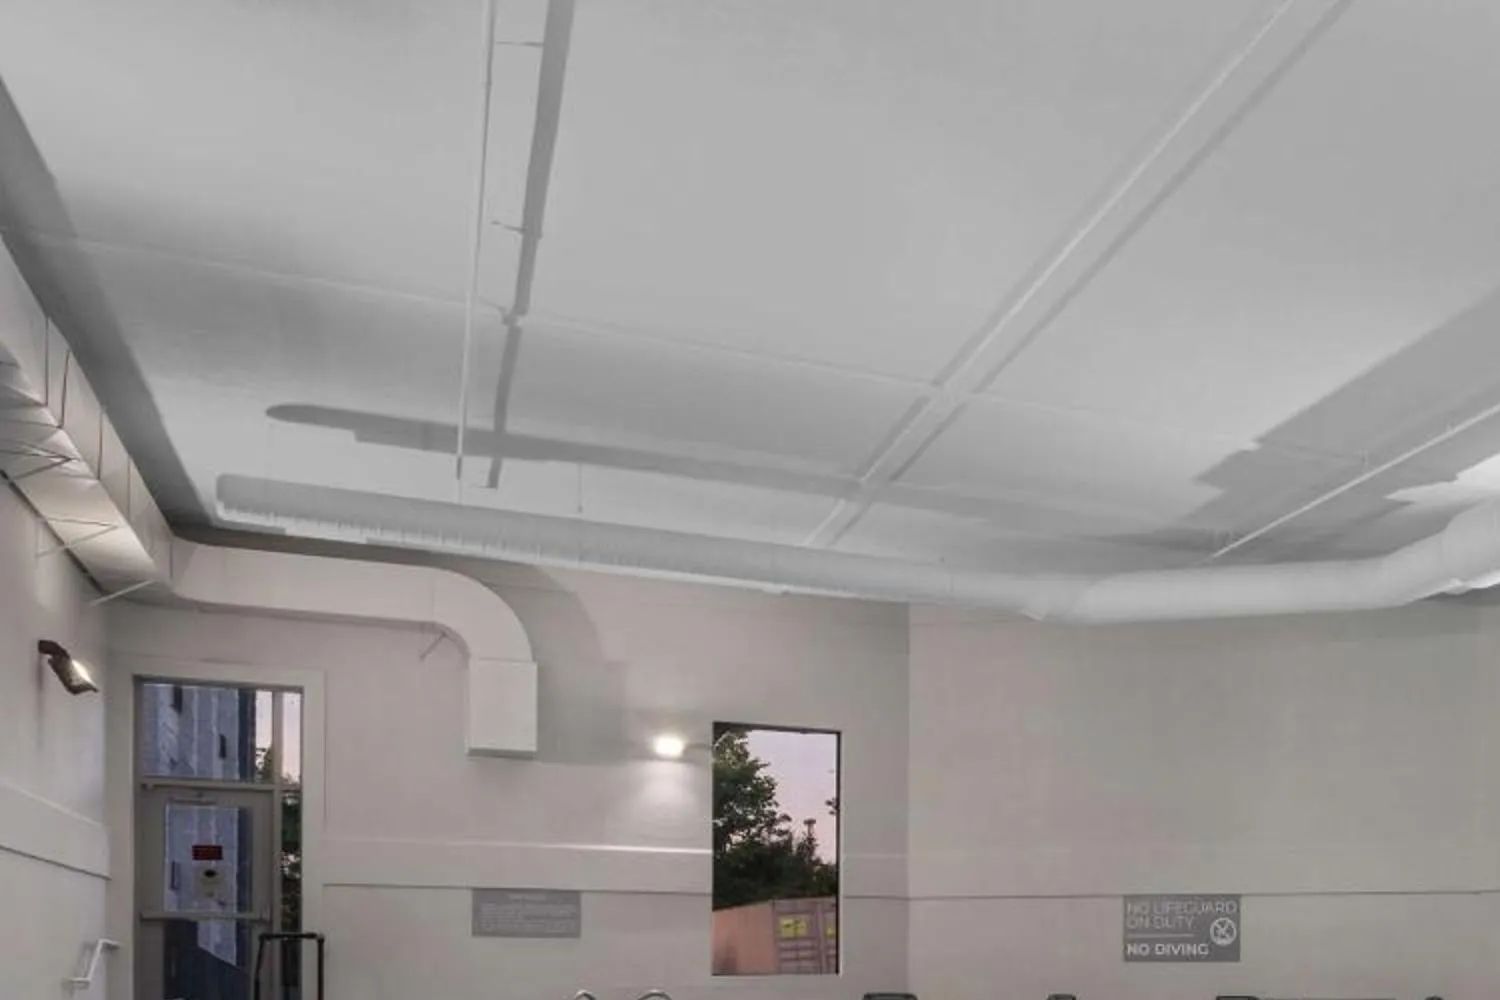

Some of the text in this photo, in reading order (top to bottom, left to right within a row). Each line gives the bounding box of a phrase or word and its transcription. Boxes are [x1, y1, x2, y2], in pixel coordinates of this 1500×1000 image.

[1127, 900, 1238, 915] NO LIFEGUARD
[1126, 915, 1195, 930] ON DUTY
[1126, 943, 1209, 956] NO DIVING
